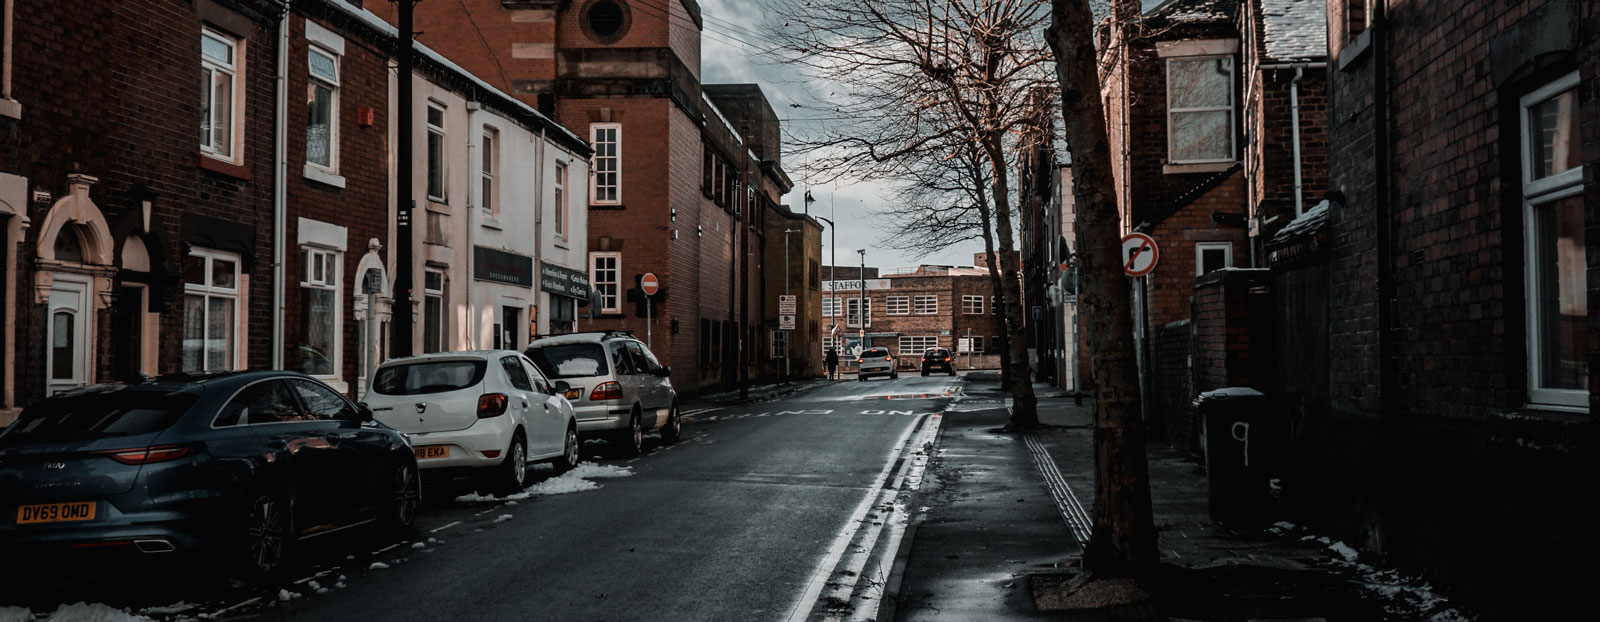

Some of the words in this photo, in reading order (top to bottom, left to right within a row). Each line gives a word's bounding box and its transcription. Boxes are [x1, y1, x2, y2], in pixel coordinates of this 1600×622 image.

[428, 447, 446, 457] EKA
[22, 505, 58, 521] DV69
[61, 503, 89, 519] OMD
